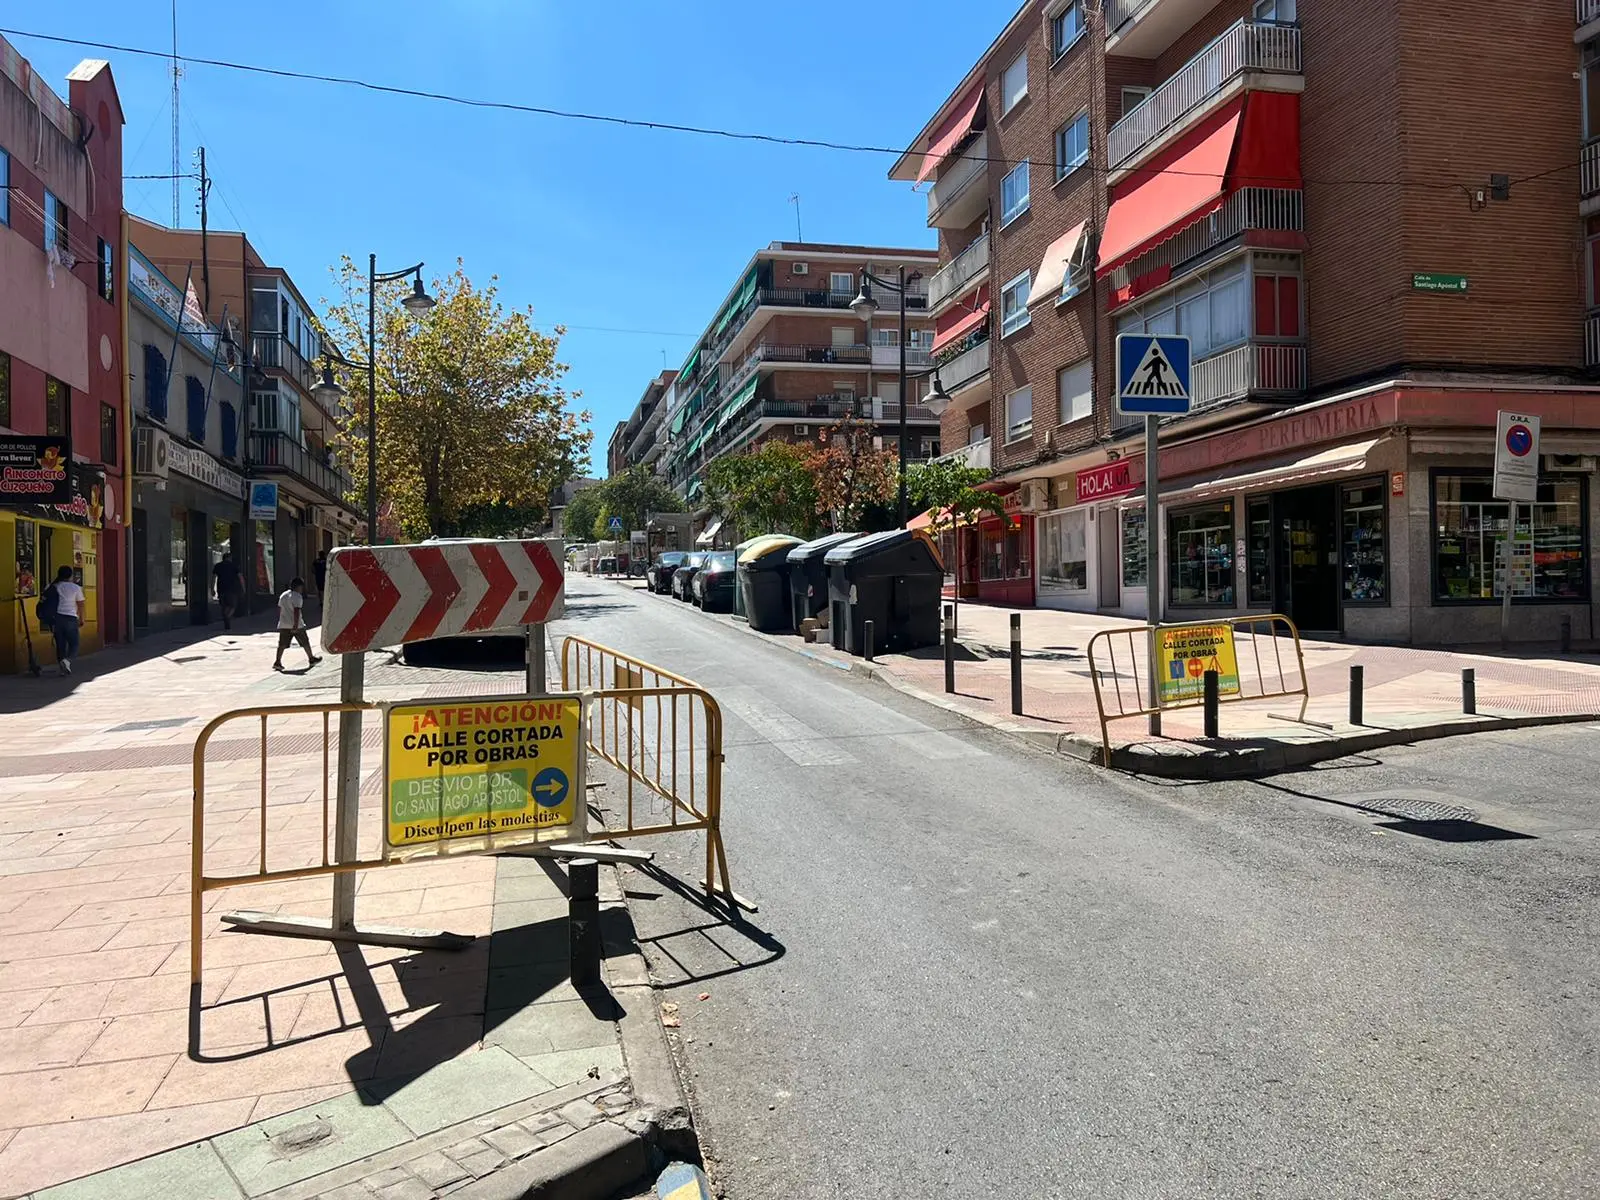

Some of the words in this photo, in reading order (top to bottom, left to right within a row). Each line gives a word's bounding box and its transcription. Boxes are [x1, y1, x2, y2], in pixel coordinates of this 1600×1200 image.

[1415, 281, 1437, 289] Santiago
[1259, 401, 1379, 450] PERFUMERIA
[3, 466, 66, 480] RINCONCITO
[1081, 471, 1113, 496] HOLA!
[1163, 641, 1187, 650] CALLE
[1188, 637, 1225, 647] CORTADA
[1173, 651, 1190, 660] POR
[1190, 648, 1218, 658] OBRAS
[412, 700, 563, 733] ¡ATENCIÓN!
[403, 731, 468, 751] CALLE
[474, 725, 564, 745] CORTADA
[427, 749, 468, 767] POR
[474, 744, 539, 763] OBRAS
[408, 776, 473, 797] DESVIO
[478, 771, 513, 789] POR
[410, 793, 469, 815] SANTIAGO
[404, 821, 474, 839] Disculpen
[478, 817, 497, 829] las
[501, 811, 560, 827] molestias
